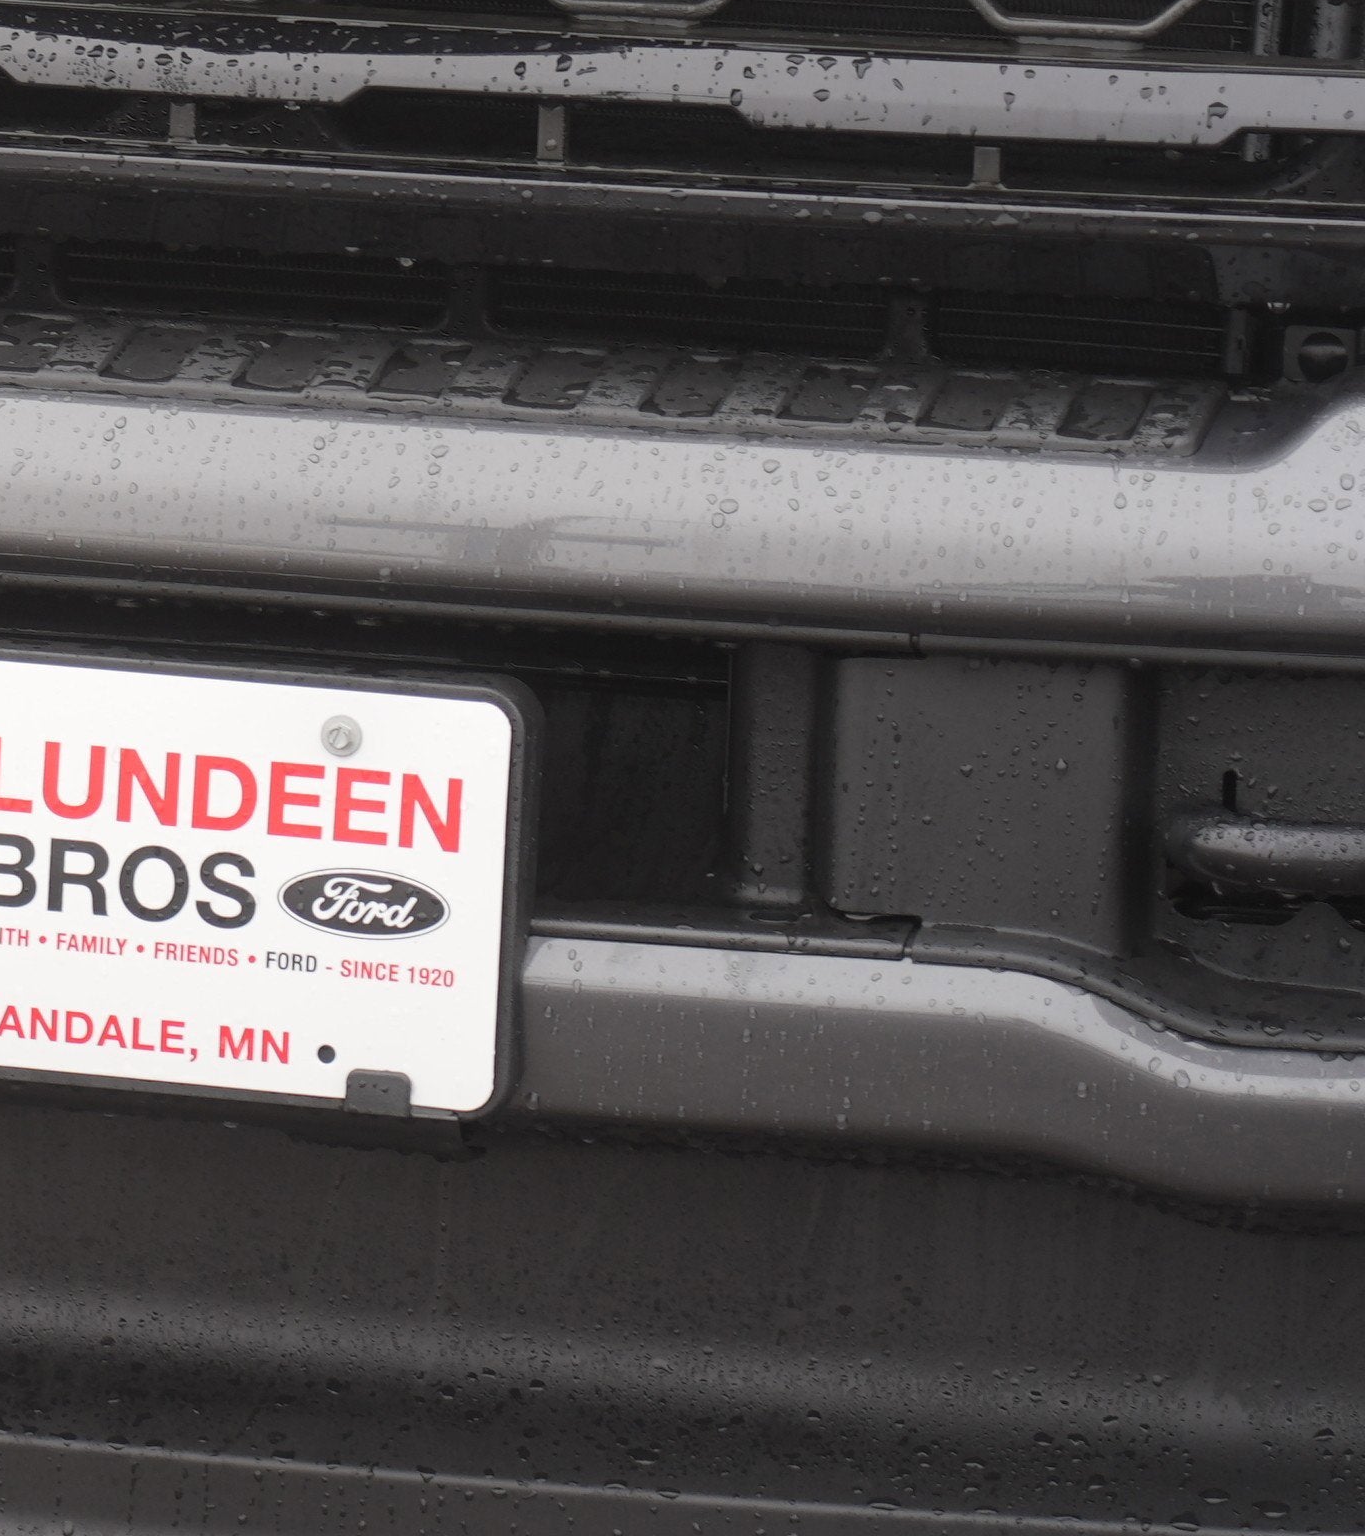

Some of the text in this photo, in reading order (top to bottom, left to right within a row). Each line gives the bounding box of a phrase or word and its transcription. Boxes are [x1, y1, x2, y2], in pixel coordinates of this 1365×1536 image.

[312, 876, 419, 929] Ford
[56, 932, 128, 957] FAMILY
[154, 941, 239, 967] FRIENDS
[265, 950, 318, 973] FORD
[340, 959, 400, 983] SINCE
[407, 966, 454, 988] 1920
[218, 1024, 290, 1065] MN
